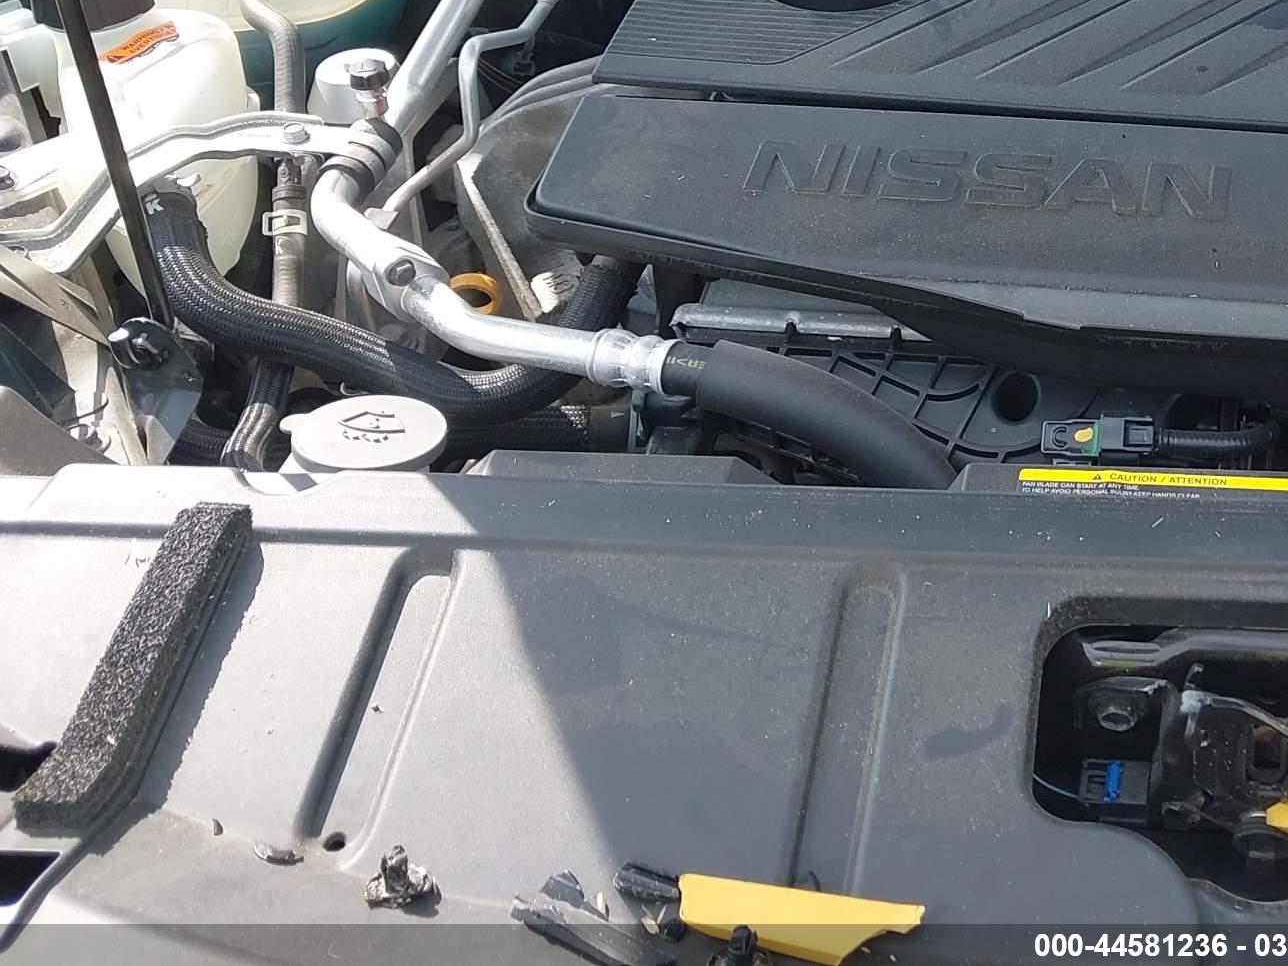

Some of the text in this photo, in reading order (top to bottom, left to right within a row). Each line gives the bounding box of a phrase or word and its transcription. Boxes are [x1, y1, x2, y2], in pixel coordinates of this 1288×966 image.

[743, 141, 1233, 222] NISSAN
[1109, 472, 1157, 482] CAUTION
[1169, 476, 1227, 486] ATTENTION
